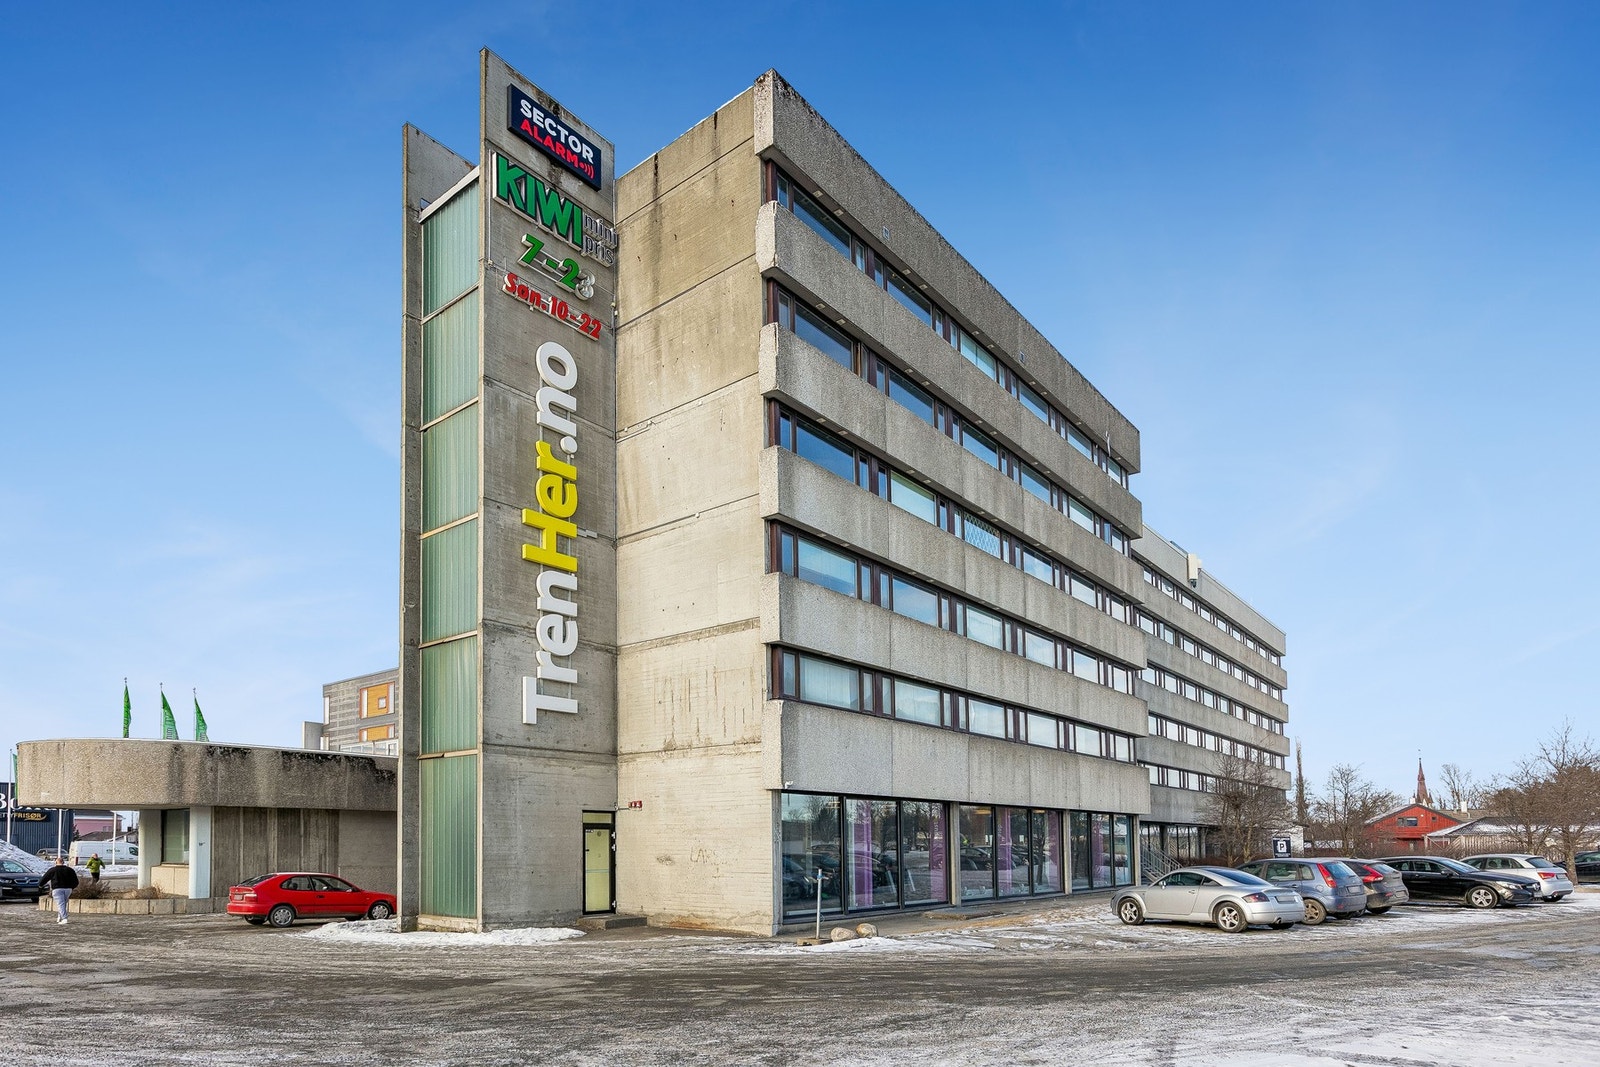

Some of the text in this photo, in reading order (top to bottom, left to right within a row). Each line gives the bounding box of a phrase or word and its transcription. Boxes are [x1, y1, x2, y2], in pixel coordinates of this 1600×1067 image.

[520, 99, 594, 164] SECTOR
[520, 119, 579, 169] ALARM
[493, 152, 583, 250] KIWI
[583, 213, 618, 248] mini
[583, 234, 615, 267] pris
[522, 341, 578, 724] TrenHer.no
